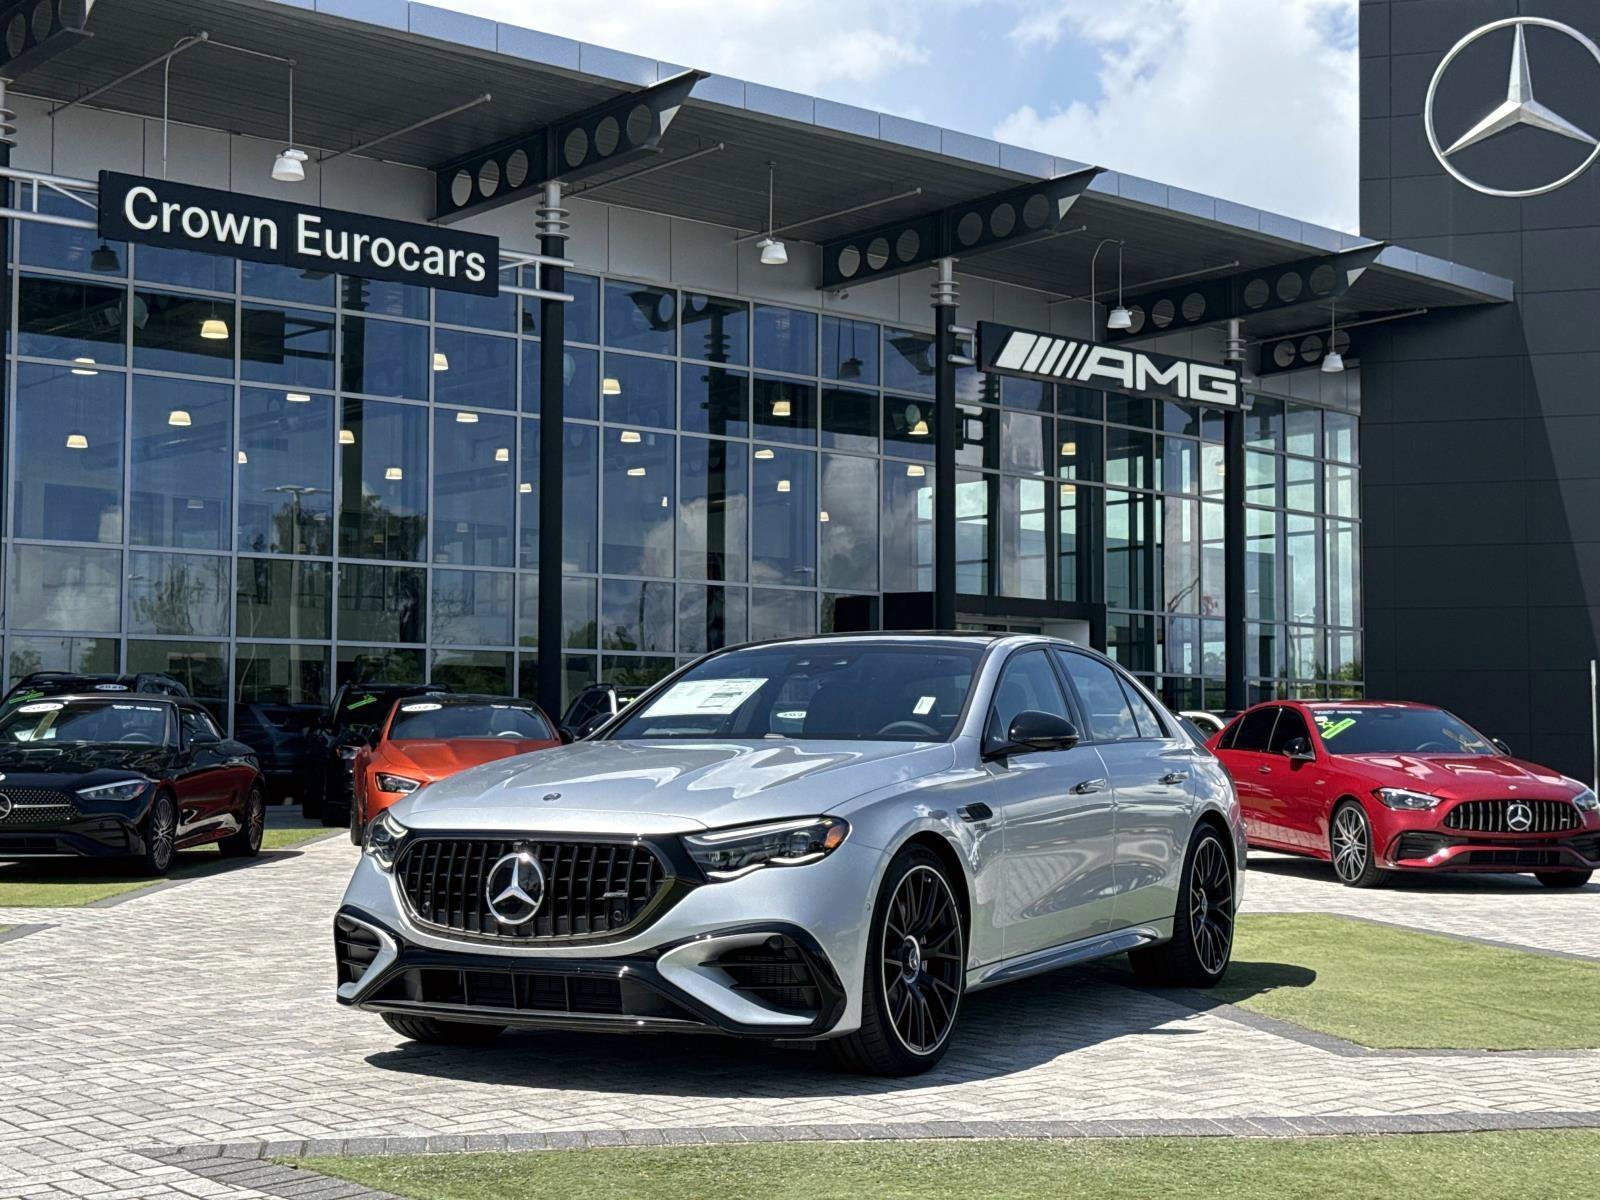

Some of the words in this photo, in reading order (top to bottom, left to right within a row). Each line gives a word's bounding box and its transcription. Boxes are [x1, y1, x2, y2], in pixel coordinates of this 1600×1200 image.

[124, 186, 279, 251] Crown
[296, 213, 487, 282] Eurocars
[1076, 345, 1237, 406] AMG
